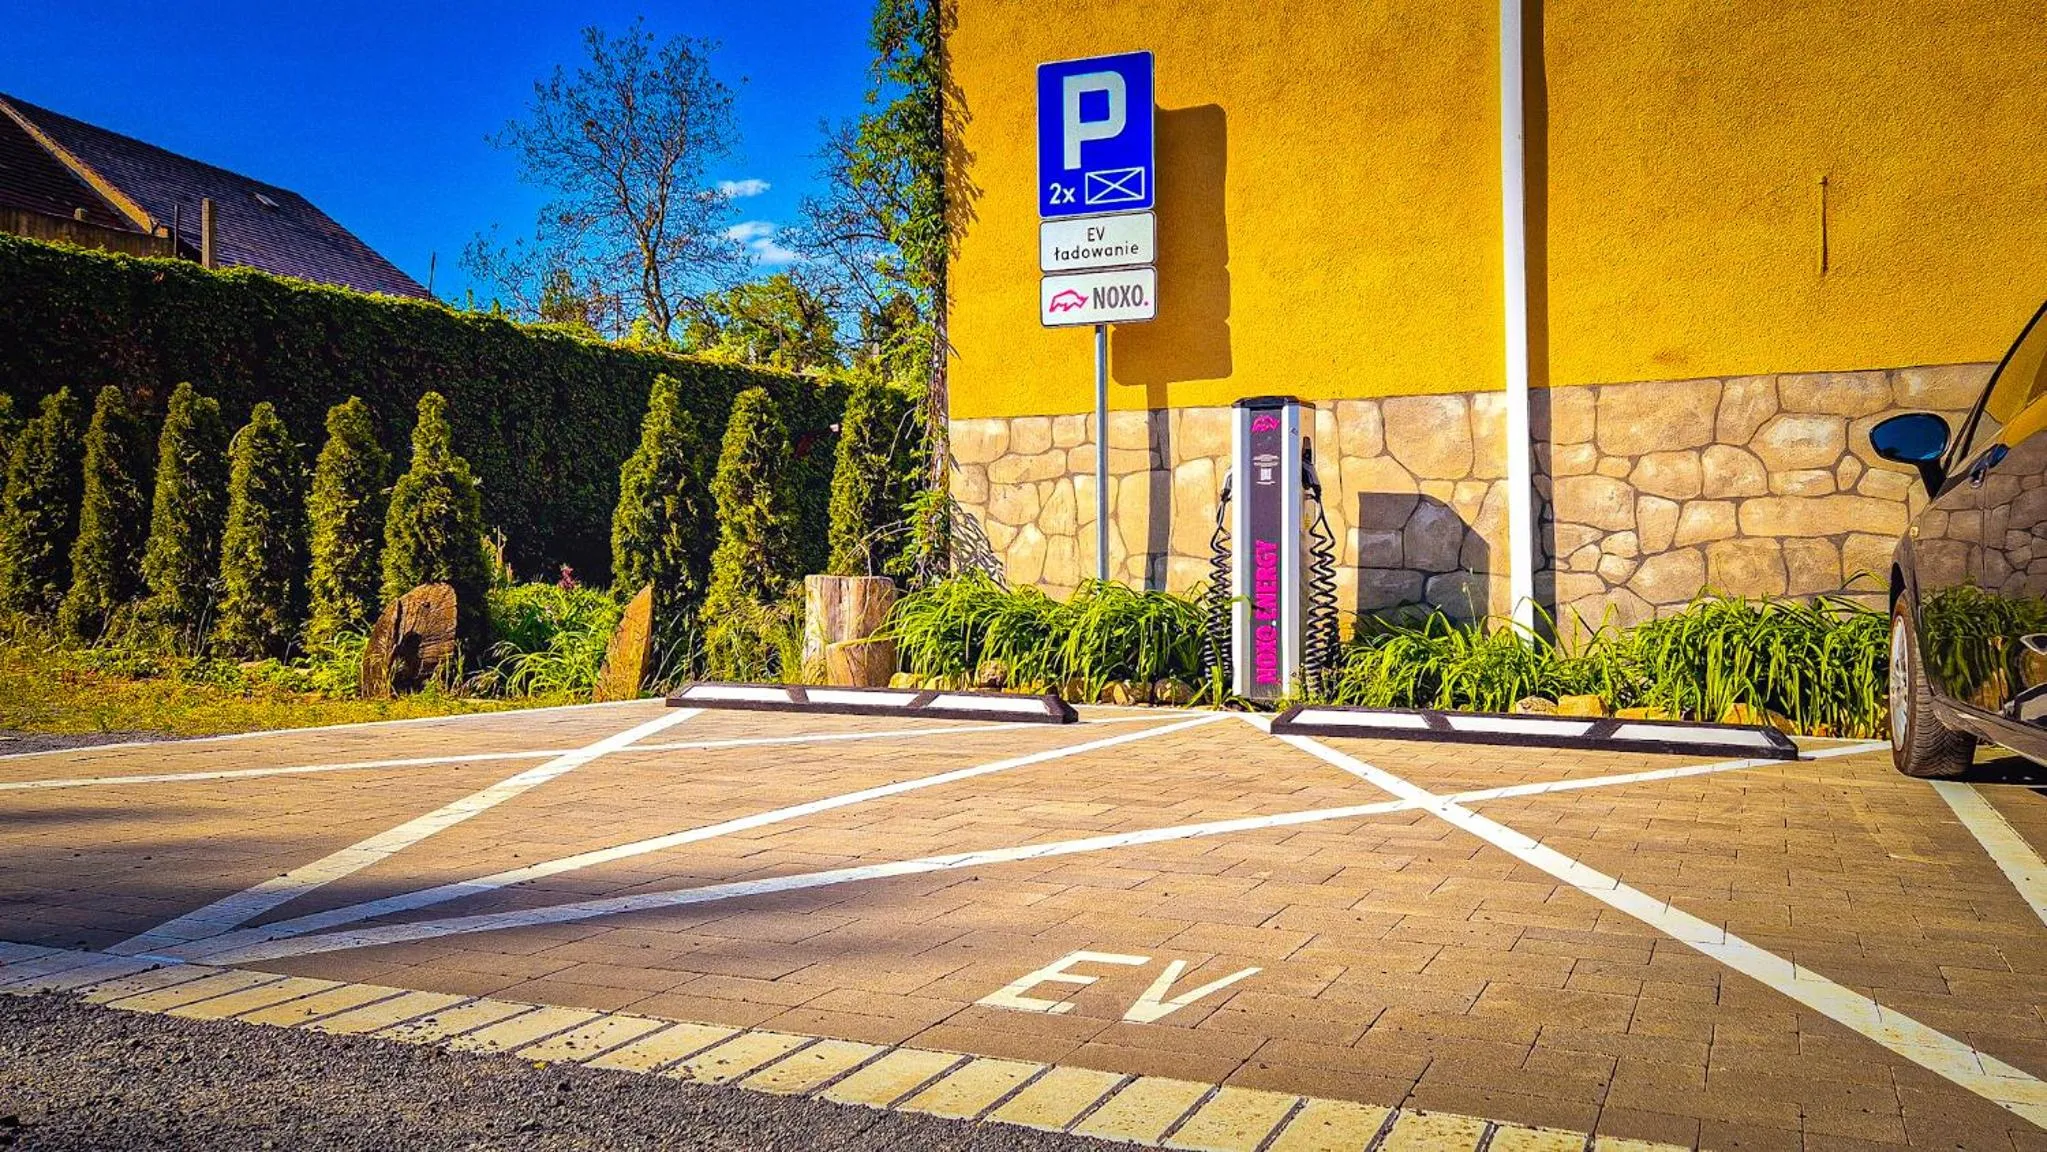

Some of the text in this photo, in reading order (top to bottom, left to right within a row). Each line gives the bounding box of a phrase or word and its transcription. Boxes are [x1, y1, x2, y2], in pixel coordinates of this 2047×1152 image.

[1063, 70, 1127, 170] P
[1049, 183, 1076, 204] 2x
[1087, 226, 1105, 243] EV
[1053, 240, 1139, 261] ładowanie
[1093, 284, 1149, 309] NOXO.
[972, 950, 1263, 1024] EV
